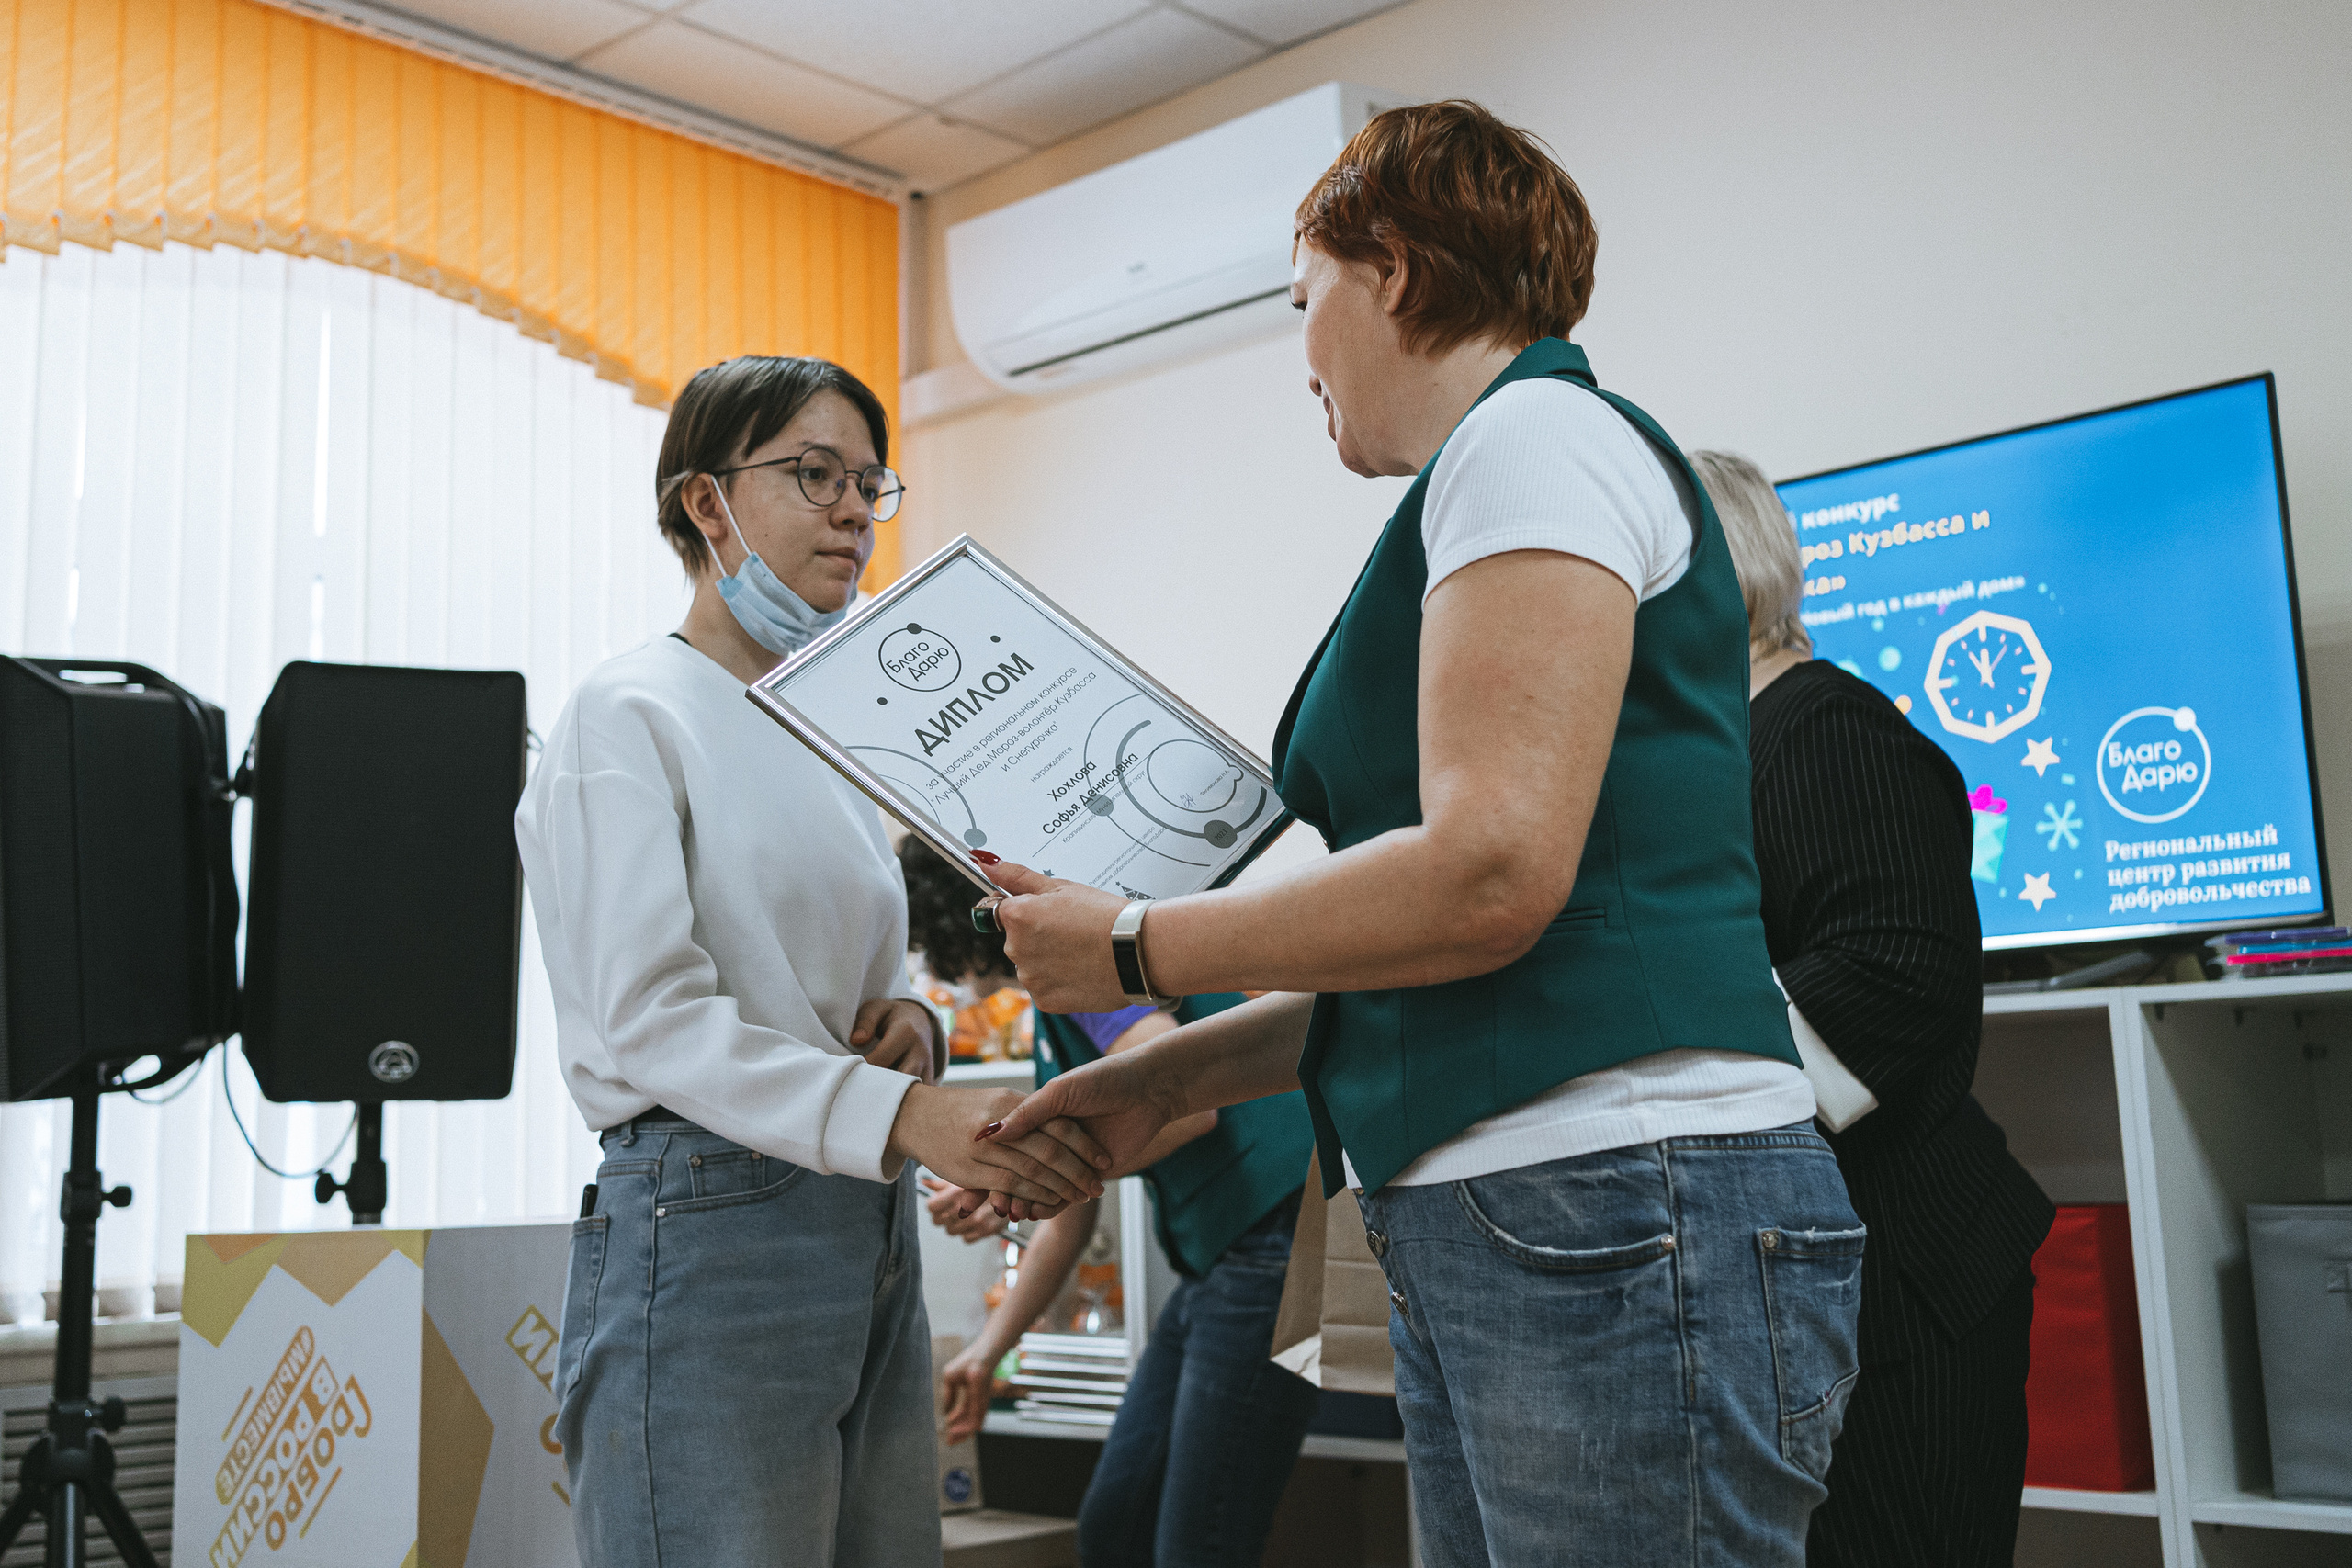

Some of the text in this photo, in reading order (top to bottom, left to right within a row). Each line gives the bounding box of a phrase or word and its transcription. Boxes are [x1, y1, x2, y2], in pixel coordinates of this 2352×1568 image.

[1802, 493, 1899, 529] конкурс
[1802, 509, 1990, 570] роз Кузбасса и
[886, 641, 930, 673] Благо
[908, 647, 950, 682] Дарю
[914, 652, 1035, 757] ДИПЛОМ
[925, 666, 1078, 790] за участие в региональном конкурсе
[968, 759, 992, 779] Дед
[986, 704, 1057, 762] Мороз-волонтёр
[1056, 671, 1097, 706] Кузбасса
[1001, 720, 1058, 773] и Снегурочка"
[1030, 746, 1073, 783] награждается
[2108, 739, 2182, 768] Благо
[1042, 803, 1081, 834] Софья
[1079, 752, 1139, 807] Денисовна
[1046, 761, 1097, 802] Хохлова
[2121, 761, 2198, 794] Дарю
[1214, 829, 1228, 840] 2021
[2105, 823, 2278, 862] Региональный
[2107, 852, 2291, 888] центр развития
[2109, 875, 2312, 914] добровольчества
[264, 1374, 372, 1551] ДОБРО
